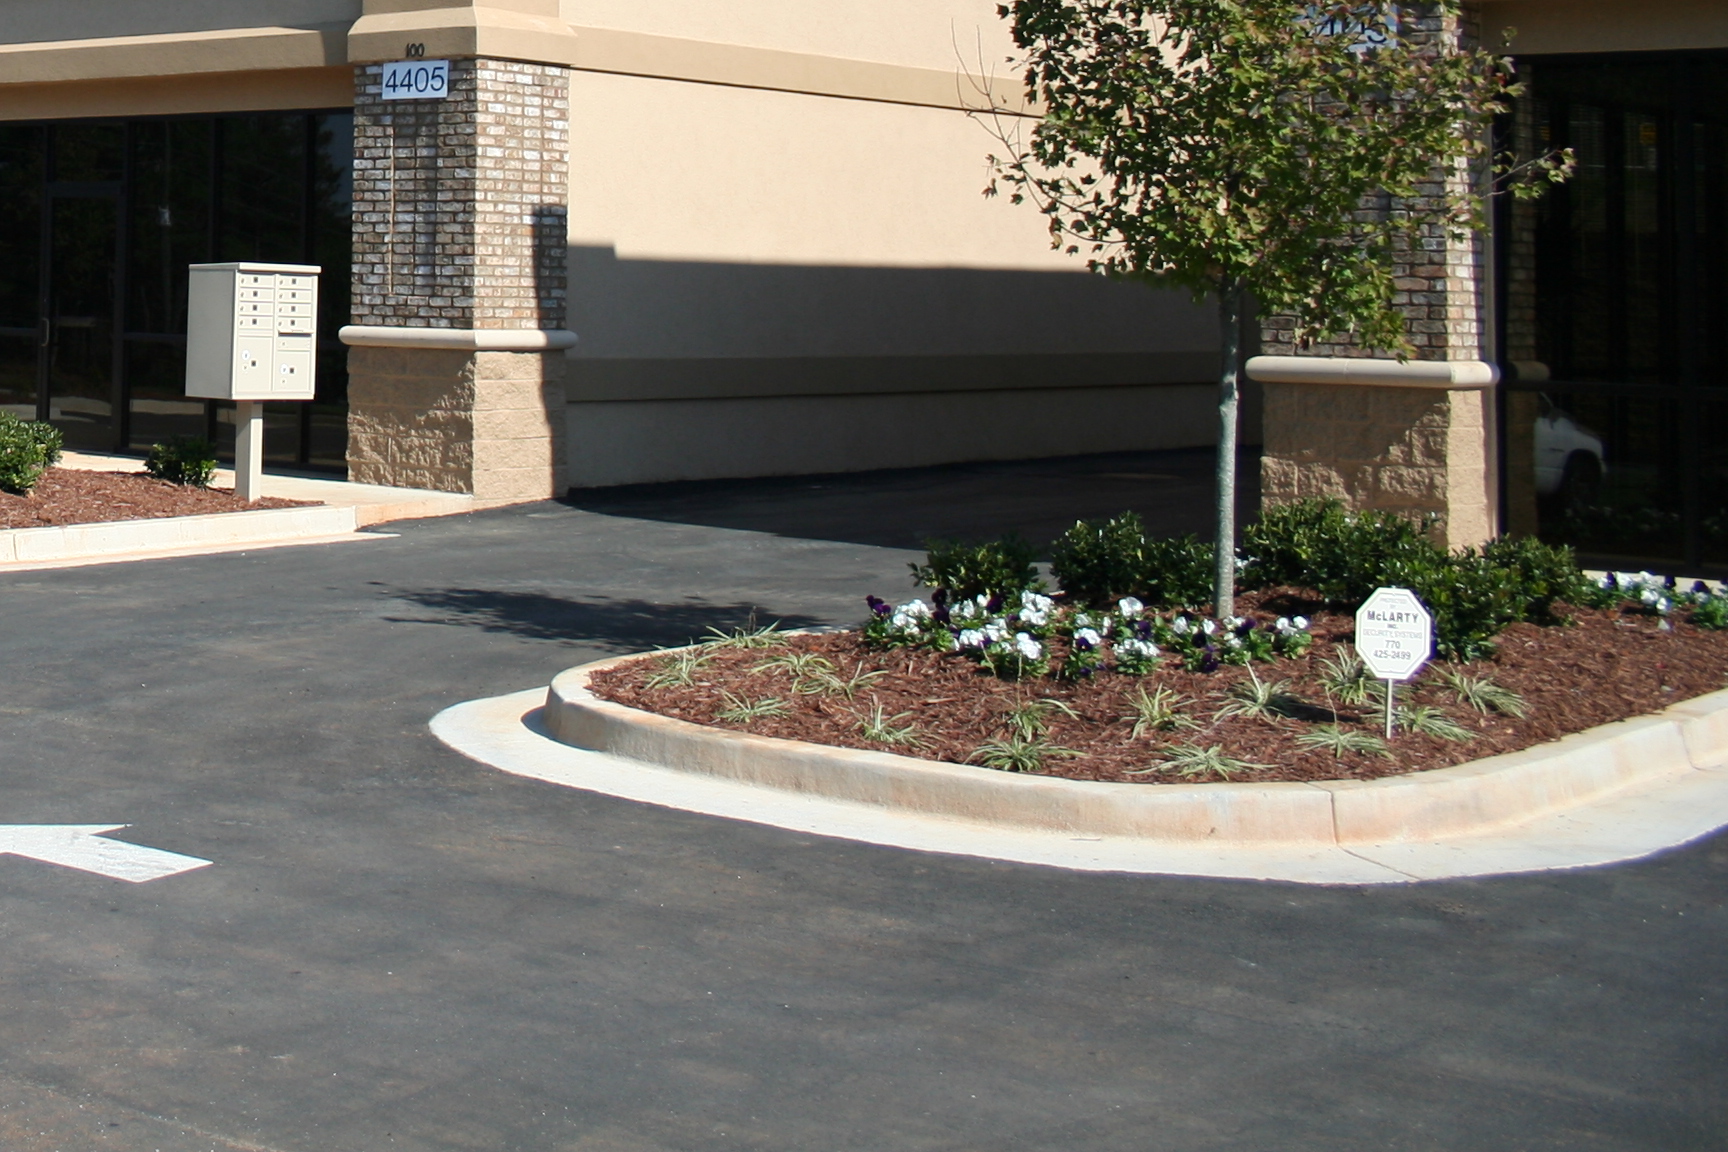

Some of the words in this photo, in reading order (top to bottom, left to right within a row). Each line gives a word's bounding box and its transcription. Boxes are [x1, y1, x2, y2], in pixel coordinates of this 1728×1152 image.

[405, 42, 425, 58] 100
[385, 67, 445, 93] 4405
[1367, 610, 1419, 623] McLARTY
[1385, 640, 1401, 649] 770
